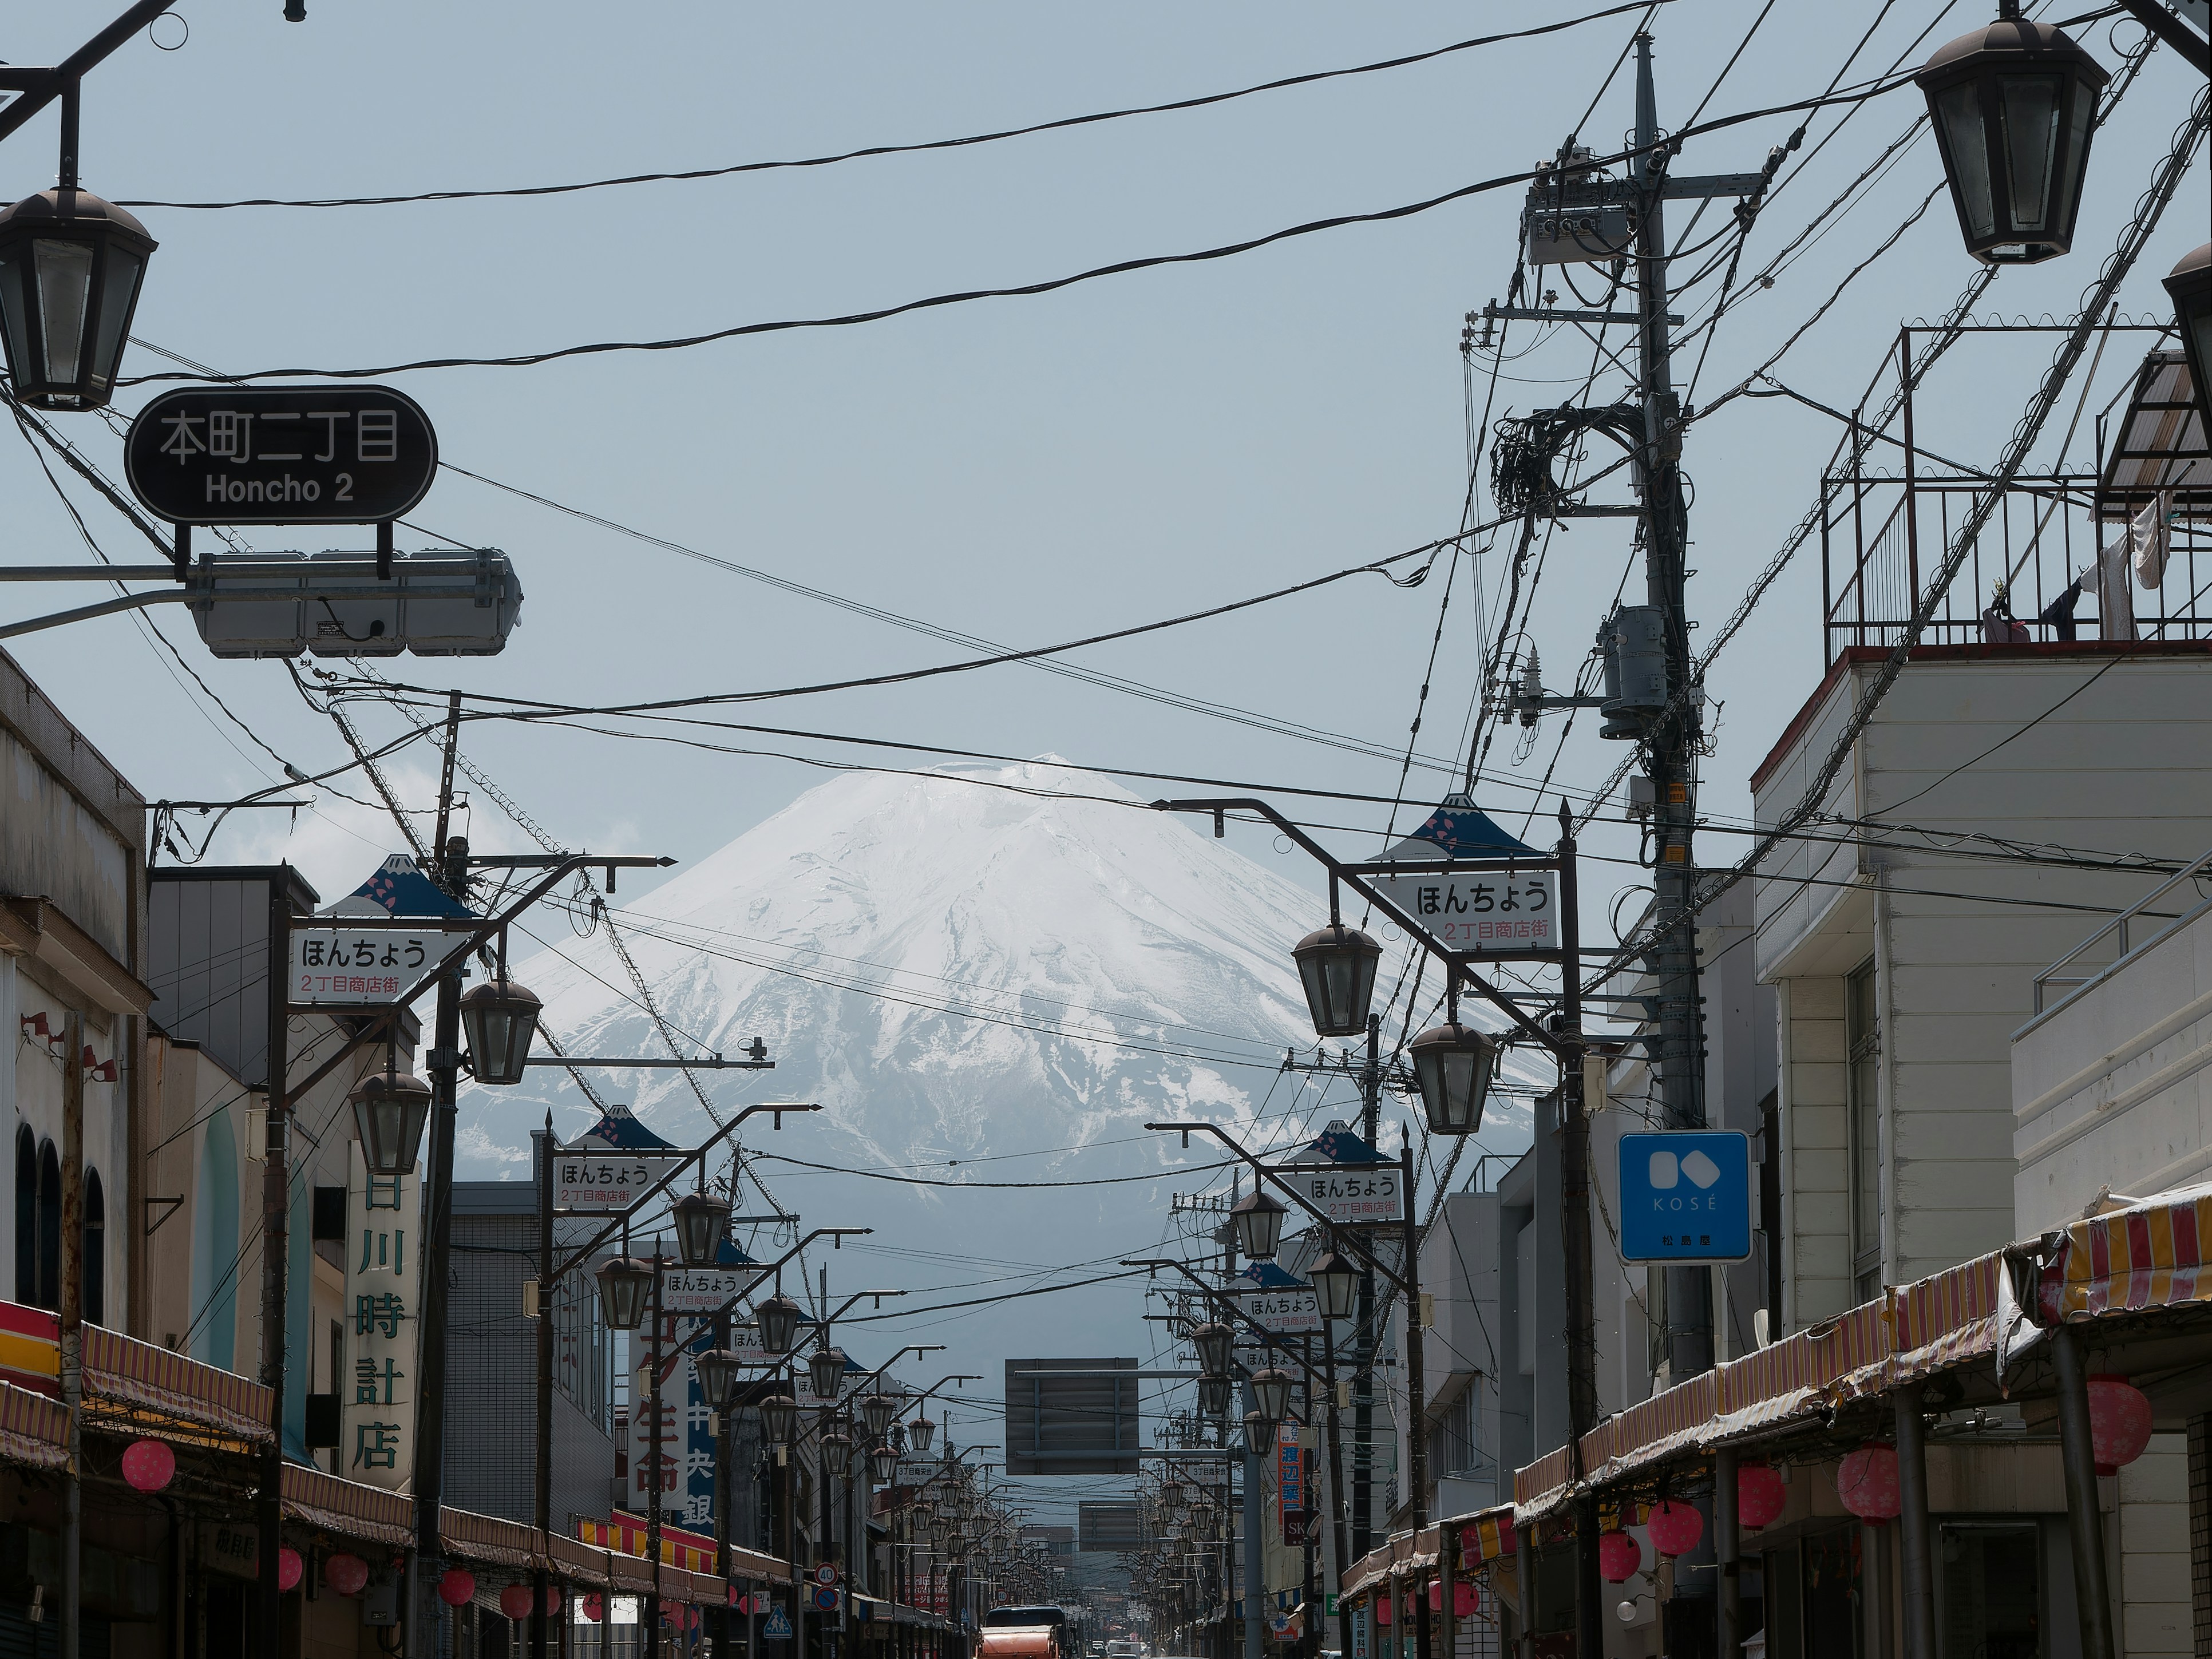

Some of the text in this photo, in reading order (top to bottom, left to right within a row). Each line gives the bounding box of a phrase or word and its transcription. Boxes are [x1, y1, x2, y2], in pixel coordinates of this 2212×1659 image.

[160, 409, 397, 465] 本町二丁目
[206, 473, 354, 502] Honcho 2
[1418, 881, 1548, 915] ほんちょう
[1444, 919, 1548, 940] 2丁目商店街
[302, 939, 426, 968] ほんちょう
[301, 975, 399, 994] 2丁目商店街
[562, 1164, 648, 1185] ほんちょう
[561, 1190, 630, 1202] 2丁目商店街
[1311, 1176, 1394, 1199] ほんちょう
[1329, 1201, 1396, 1215] 2丁目商店街
[1653, 1194, 1716, 1211] KOSÉ
[1662, 1235, 1711, 1246] 松島屋
[668, 1276, 737, 1292] ほんちょう
[1251, 1296, 1316, 1315] ほんちょう
[821, 1570, 833, 1579] 40
